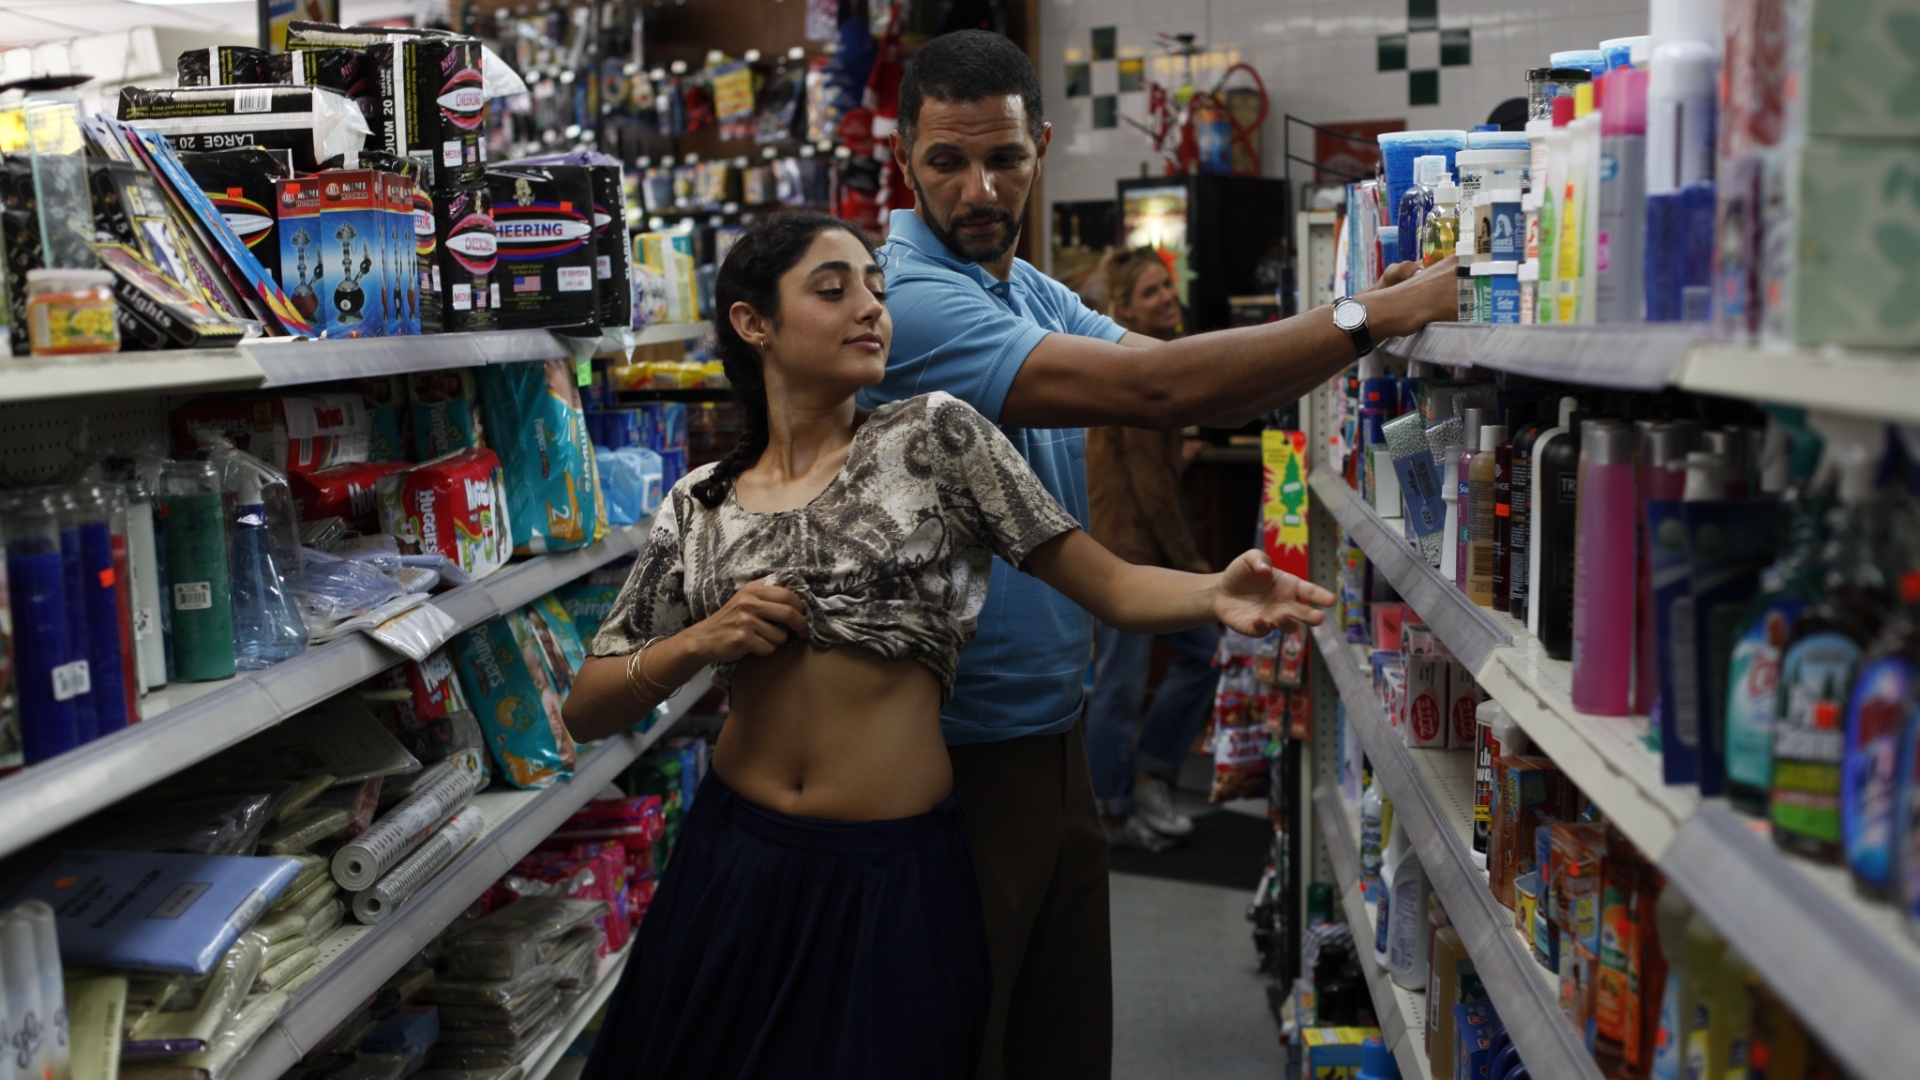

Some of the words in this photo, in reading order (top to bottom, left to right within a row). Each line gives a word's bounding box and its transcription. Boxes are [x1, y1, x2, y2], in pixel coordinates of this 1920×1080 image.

[152, 104, 164, 112] Keep
[383, 99, 394, 115] 20
[179, 136, 196, 149] 20
[204, 134, 255, 148] LARGE
[342, 181, 366, 192] MINI
[341, 192, 369, 200] HOOKAH
[495, 222, 563, 238] HEERING
[122, 284, 172, 328] Lights
[533, 417, 547, 453] Pampers
[419, 488, 438, 555] HUGGIES
[552, 505, 570, 522] 2
[1422, 510, 1433, 526] 500
[469, 625, 505, 688] Pampers
[1416, 699, 1434, 737] ZOTE
